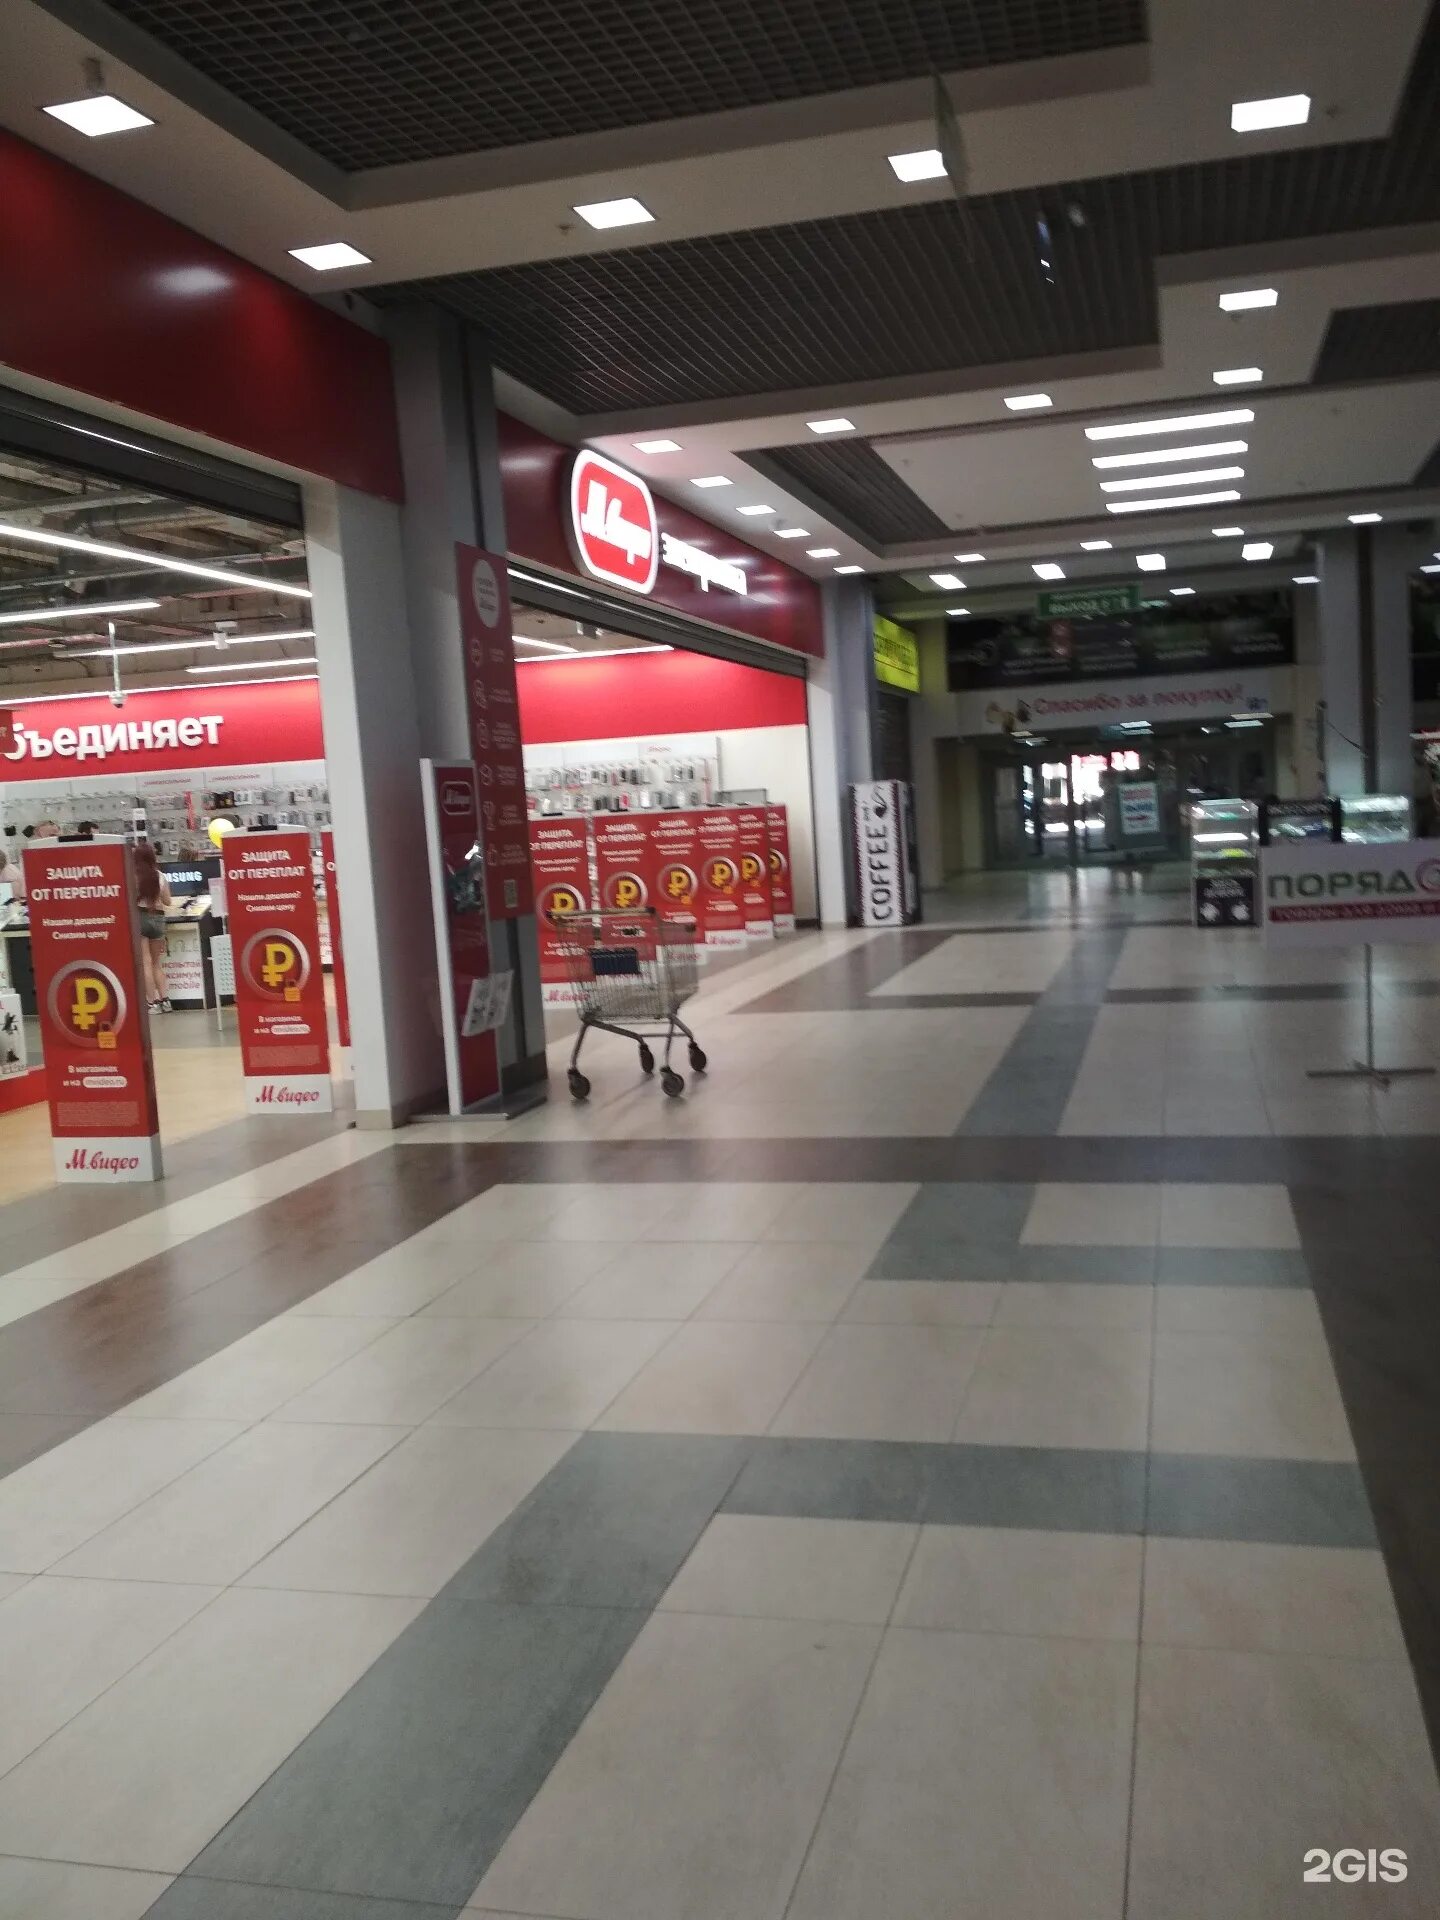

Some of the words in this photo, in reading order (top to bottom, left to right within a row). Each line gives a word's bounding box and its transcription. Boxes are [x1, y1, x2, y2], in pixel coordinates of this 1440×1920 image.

[241, 850, 292, 863] ЗАЩИТА
[46, 865, 104, 880] ЗАЩИТА
[228, 869, 247, 880] ОТ
[247, 866, 306, 879] ПЕРЕПЛАТ
[865, 824, 893, 920] COFFEE
[31, 888, 52, 901] ОТ
[53, 884, 121, 900] ПЕРЕПЛАТ
[256, 1085, 320, 1106] М.видео
[65, 1149, 140, 1174] М.видео
